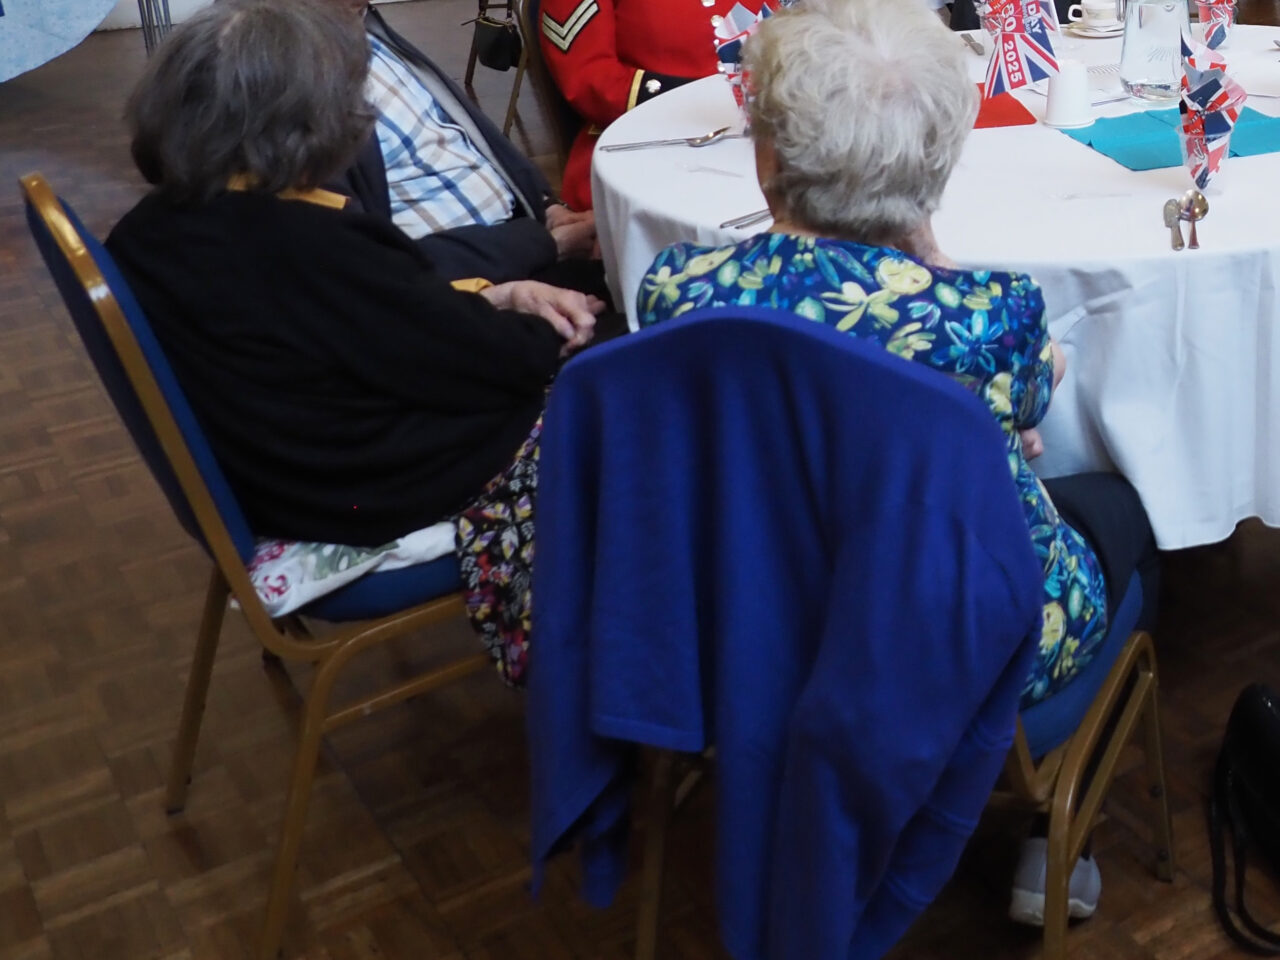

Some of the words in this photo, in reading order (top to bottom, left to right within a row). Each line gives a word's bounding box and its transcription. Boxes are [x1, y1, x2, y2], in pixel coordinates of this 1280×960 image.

[1001, 3, 1018, 32] 80
[1027, 3, 1042, 35] DAY
[1004, 40, 1023, 83] 2025
